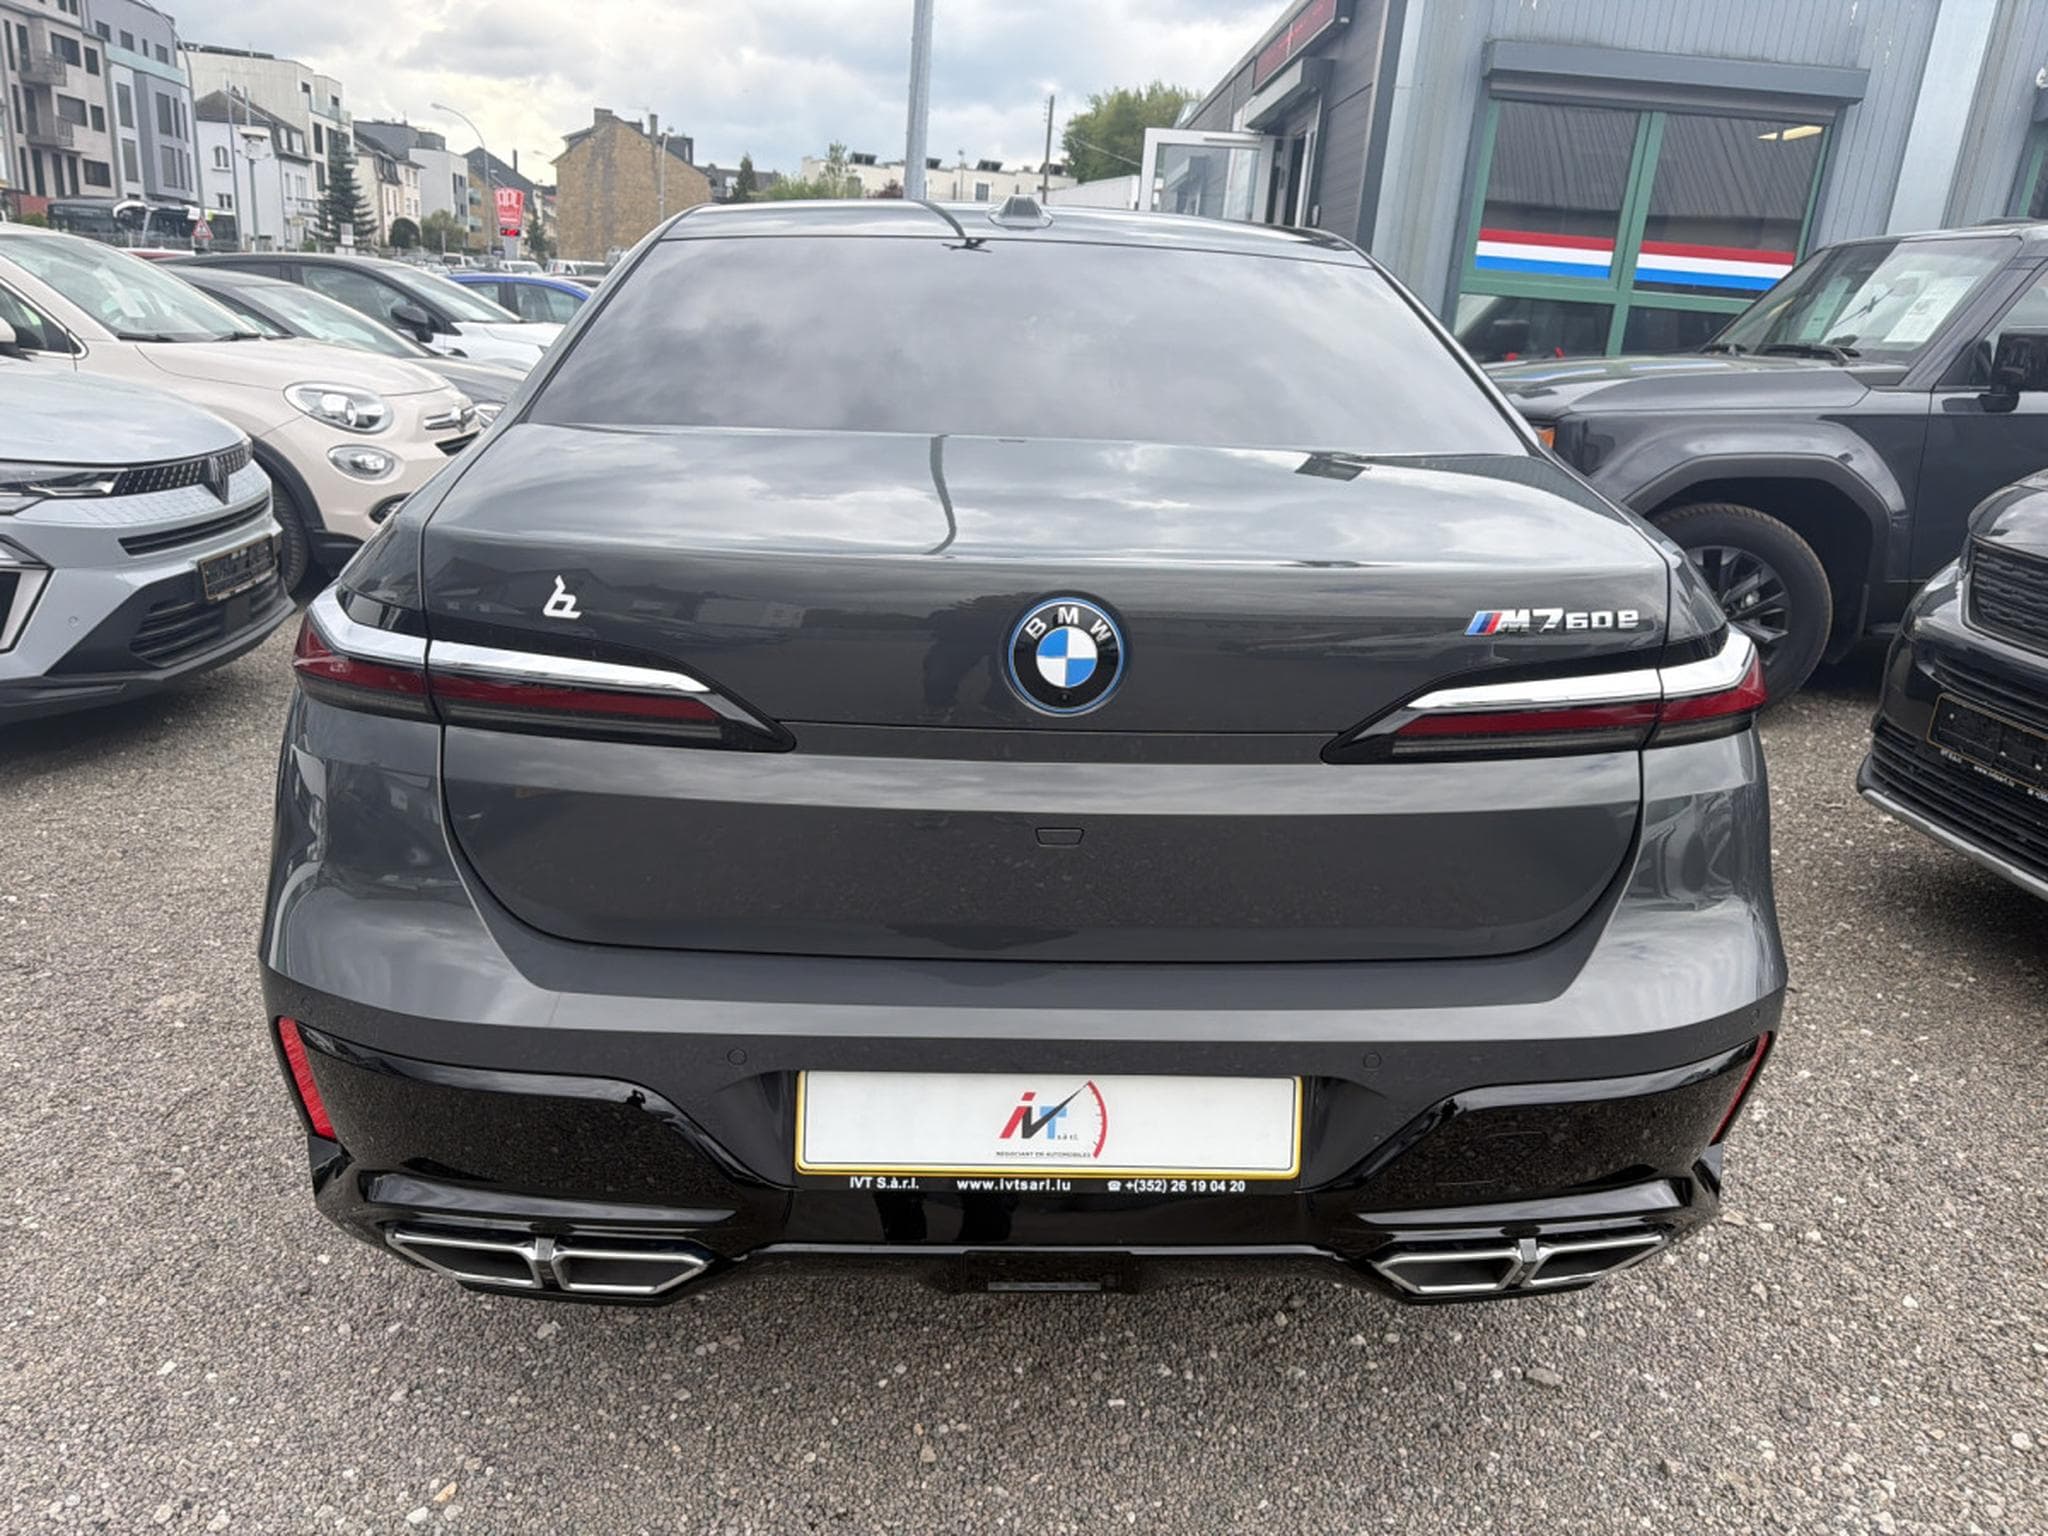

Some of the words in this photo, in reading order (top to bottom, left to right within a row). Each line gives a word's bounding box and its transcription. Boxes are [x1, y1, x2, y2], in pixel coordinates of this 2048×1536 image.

[1024, 606, 1112, 642] BMW
[850, 1176, 873, 1189] IVT
[956, 1178, 1072, 1191] www.ivtsarl.lu
[1125, 1179, 1167, 1193] +(352)
[1170, 1180, 1187, 1192] 26
[1191, 1180, 1207, 1192] 19
[1209, 1180, 1226, 1192] 04
[1229, 1180, 1246, 1193] 20
